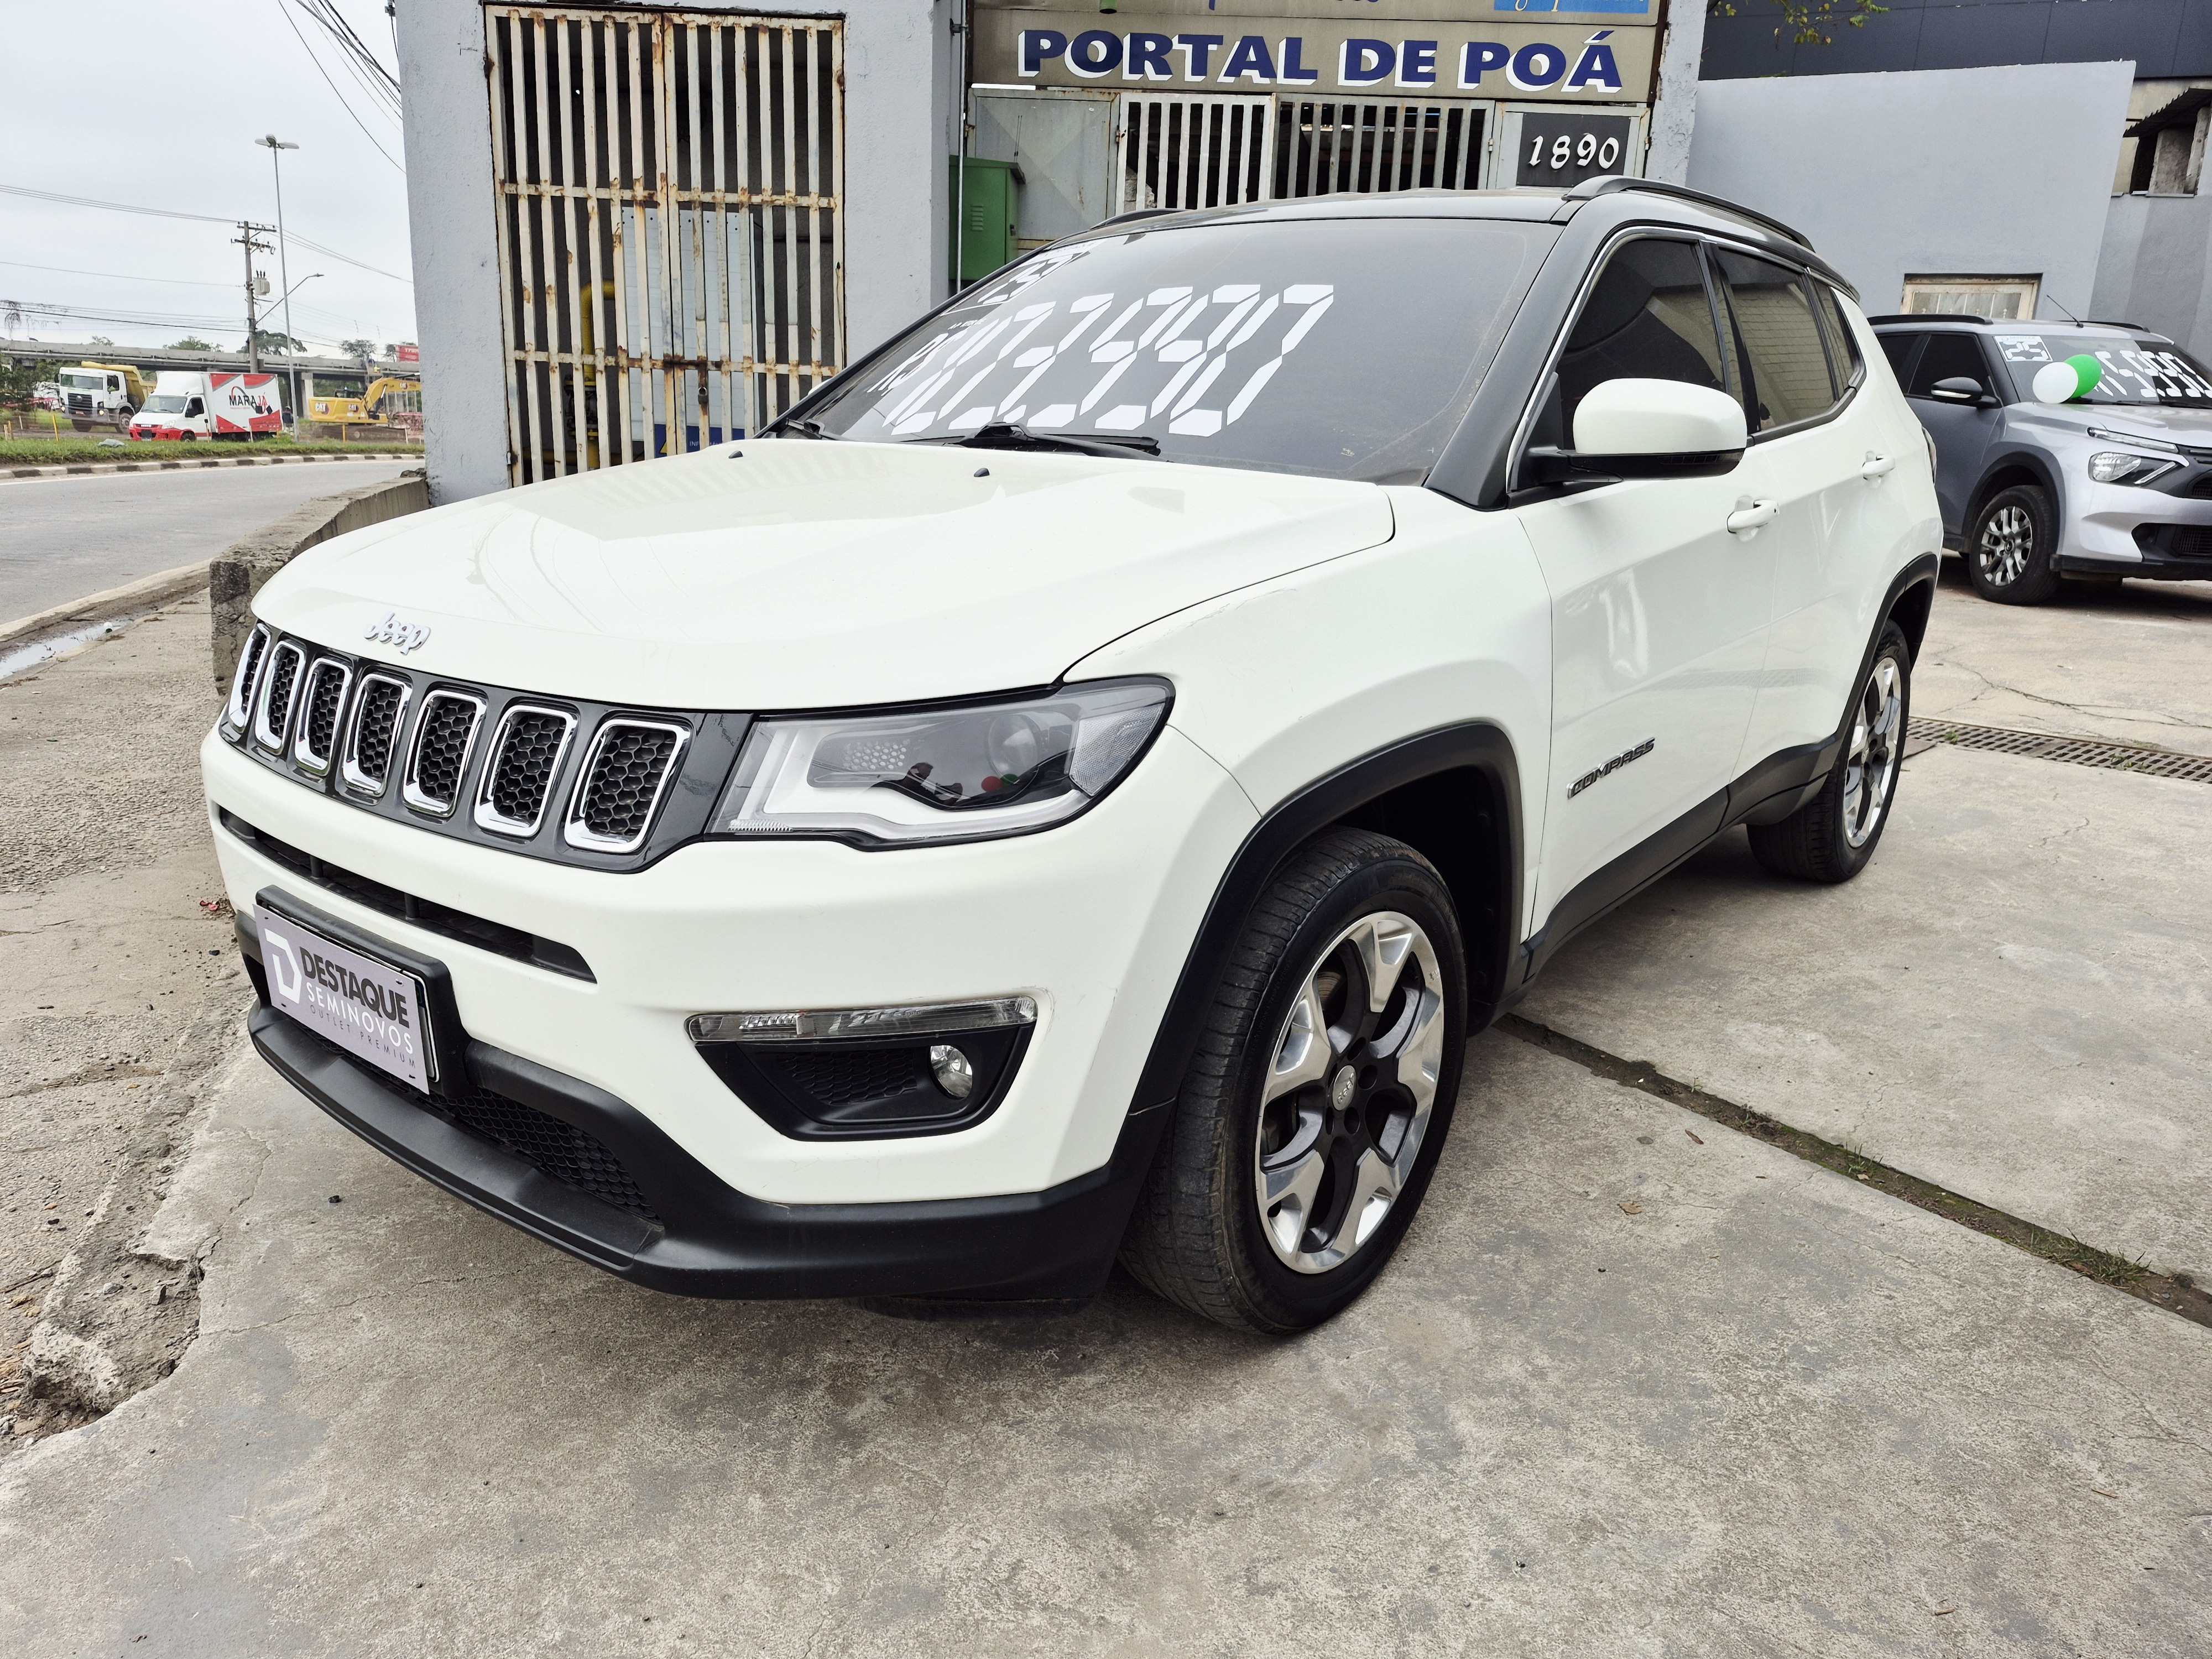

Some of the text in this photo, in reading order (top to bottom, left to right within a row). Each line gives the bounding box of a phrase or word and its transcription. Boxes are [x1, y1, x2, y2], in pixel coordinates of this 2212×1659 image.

[1018, 29, 1624, 93] PORTAL DE POÁ
[1528, 132, 1621, 171] 1890
[2003, 341, 2049, 361] 25
[228, 392, 268, 406] MARAJÁ
[315, 403, 326, 412] CAT
[364, 611, 431, 656] Jeep
[1566, 737, 1656, 800] COMPASS
[299, 946, 410, 1029] DESTAQUE
[306, 982, 414, 1055] SEMINOVOS
[310, 1005, 416, 1068] OUTLET PREMIUM
